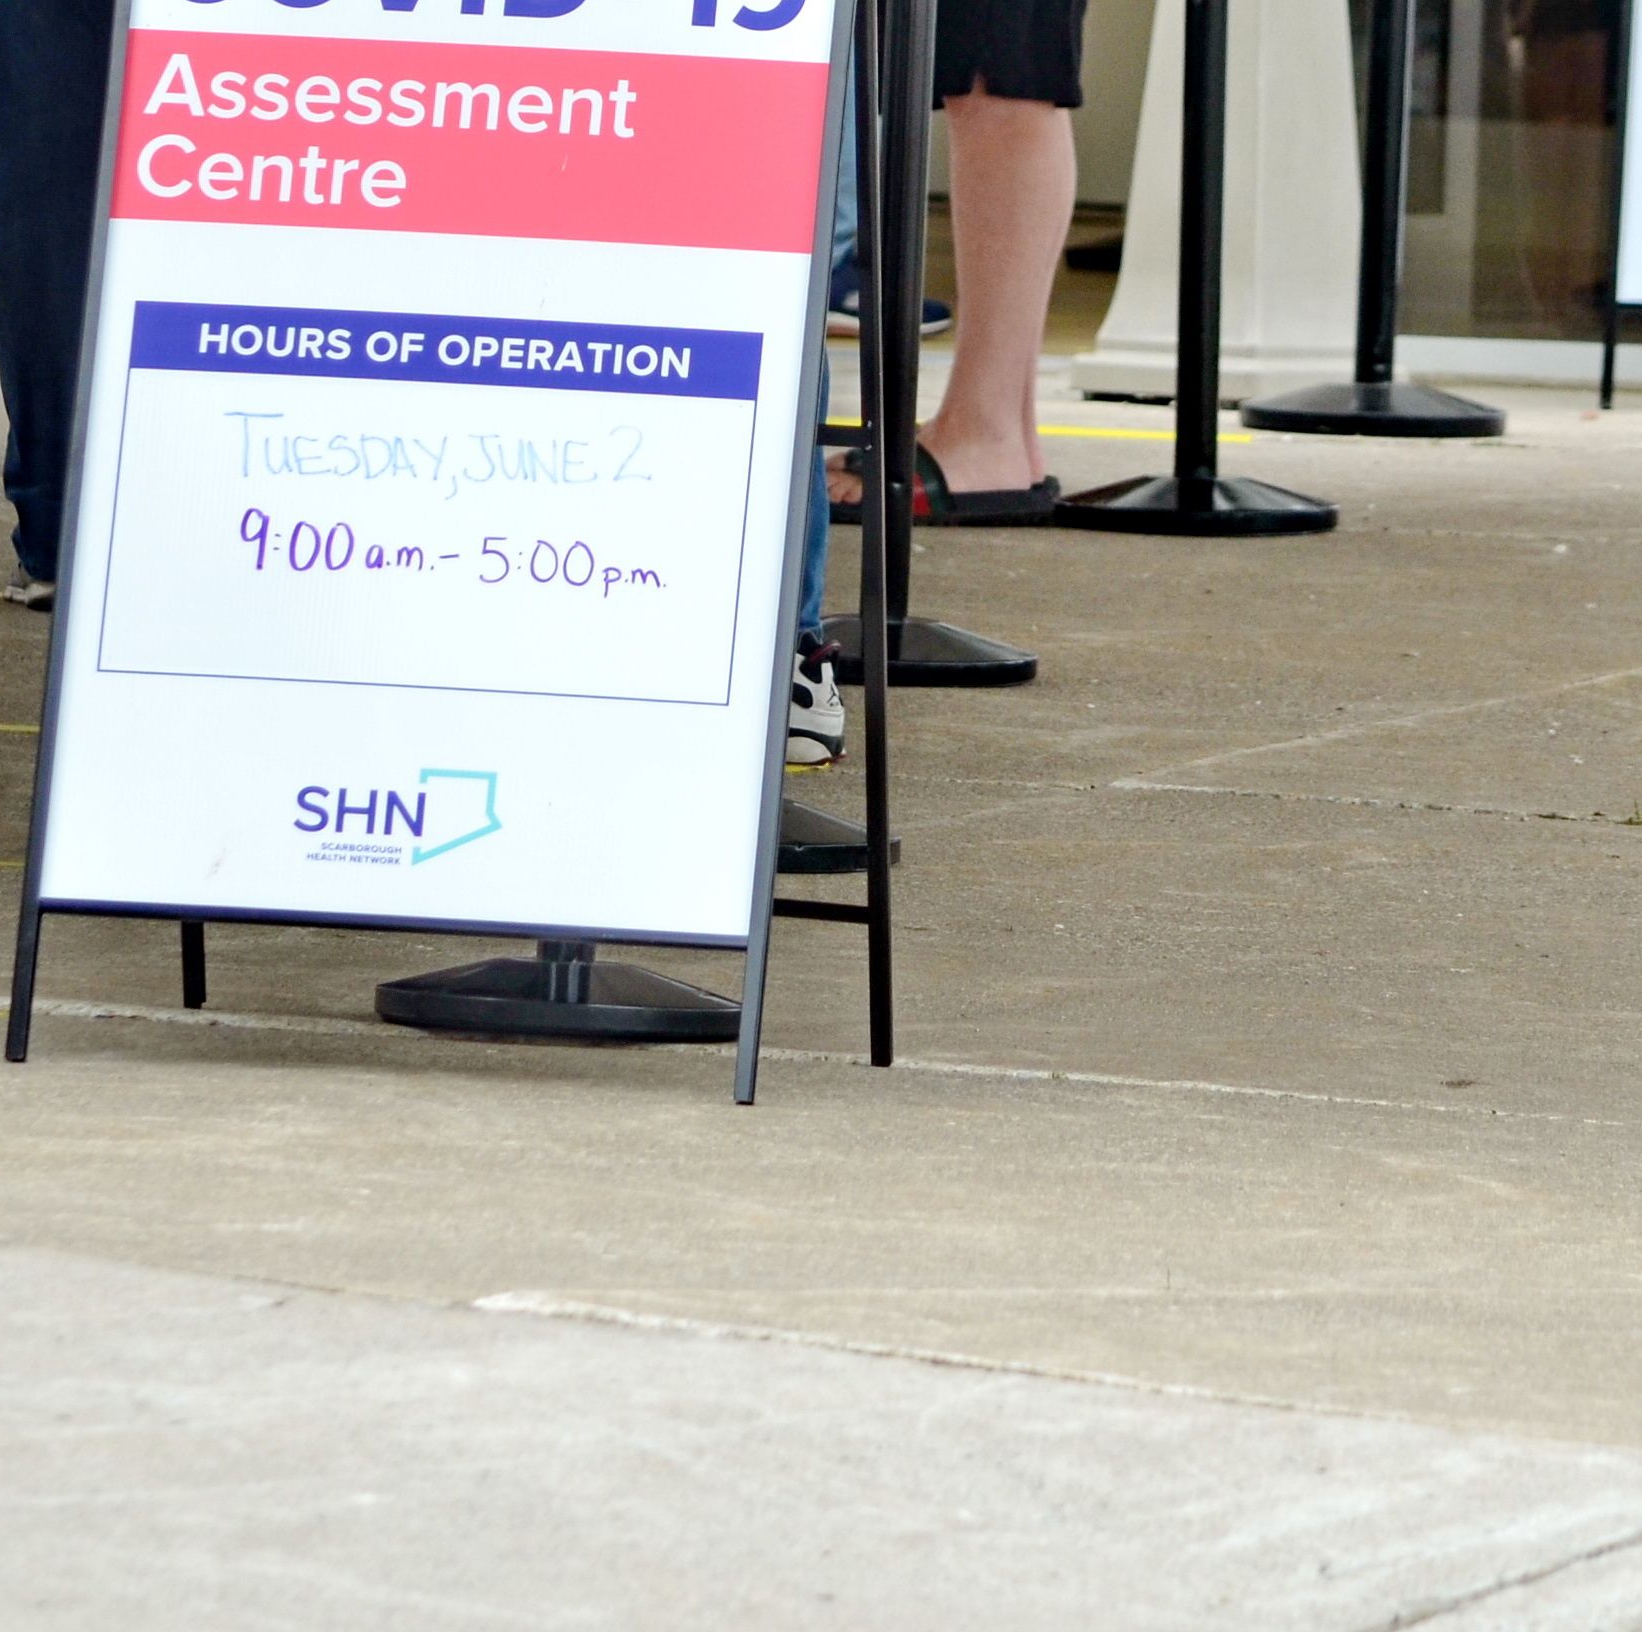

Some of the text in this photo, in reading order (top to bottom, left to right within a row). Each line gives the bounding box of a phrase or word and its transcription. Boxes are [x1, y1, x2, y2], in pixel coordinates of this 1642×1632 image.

[144, 53, 637, 139] Assessment
[137, 134, 407, 209] Centre
[198, 322, 692, 379] HOURS OF OPERATION
[609, 425, 652, 482] 2
[294, 785, 426, 838] SHN
[307, 852, 401, 866] HEALTH NETWORK
[321, 842, 402, 855] SCARBOROUGH
